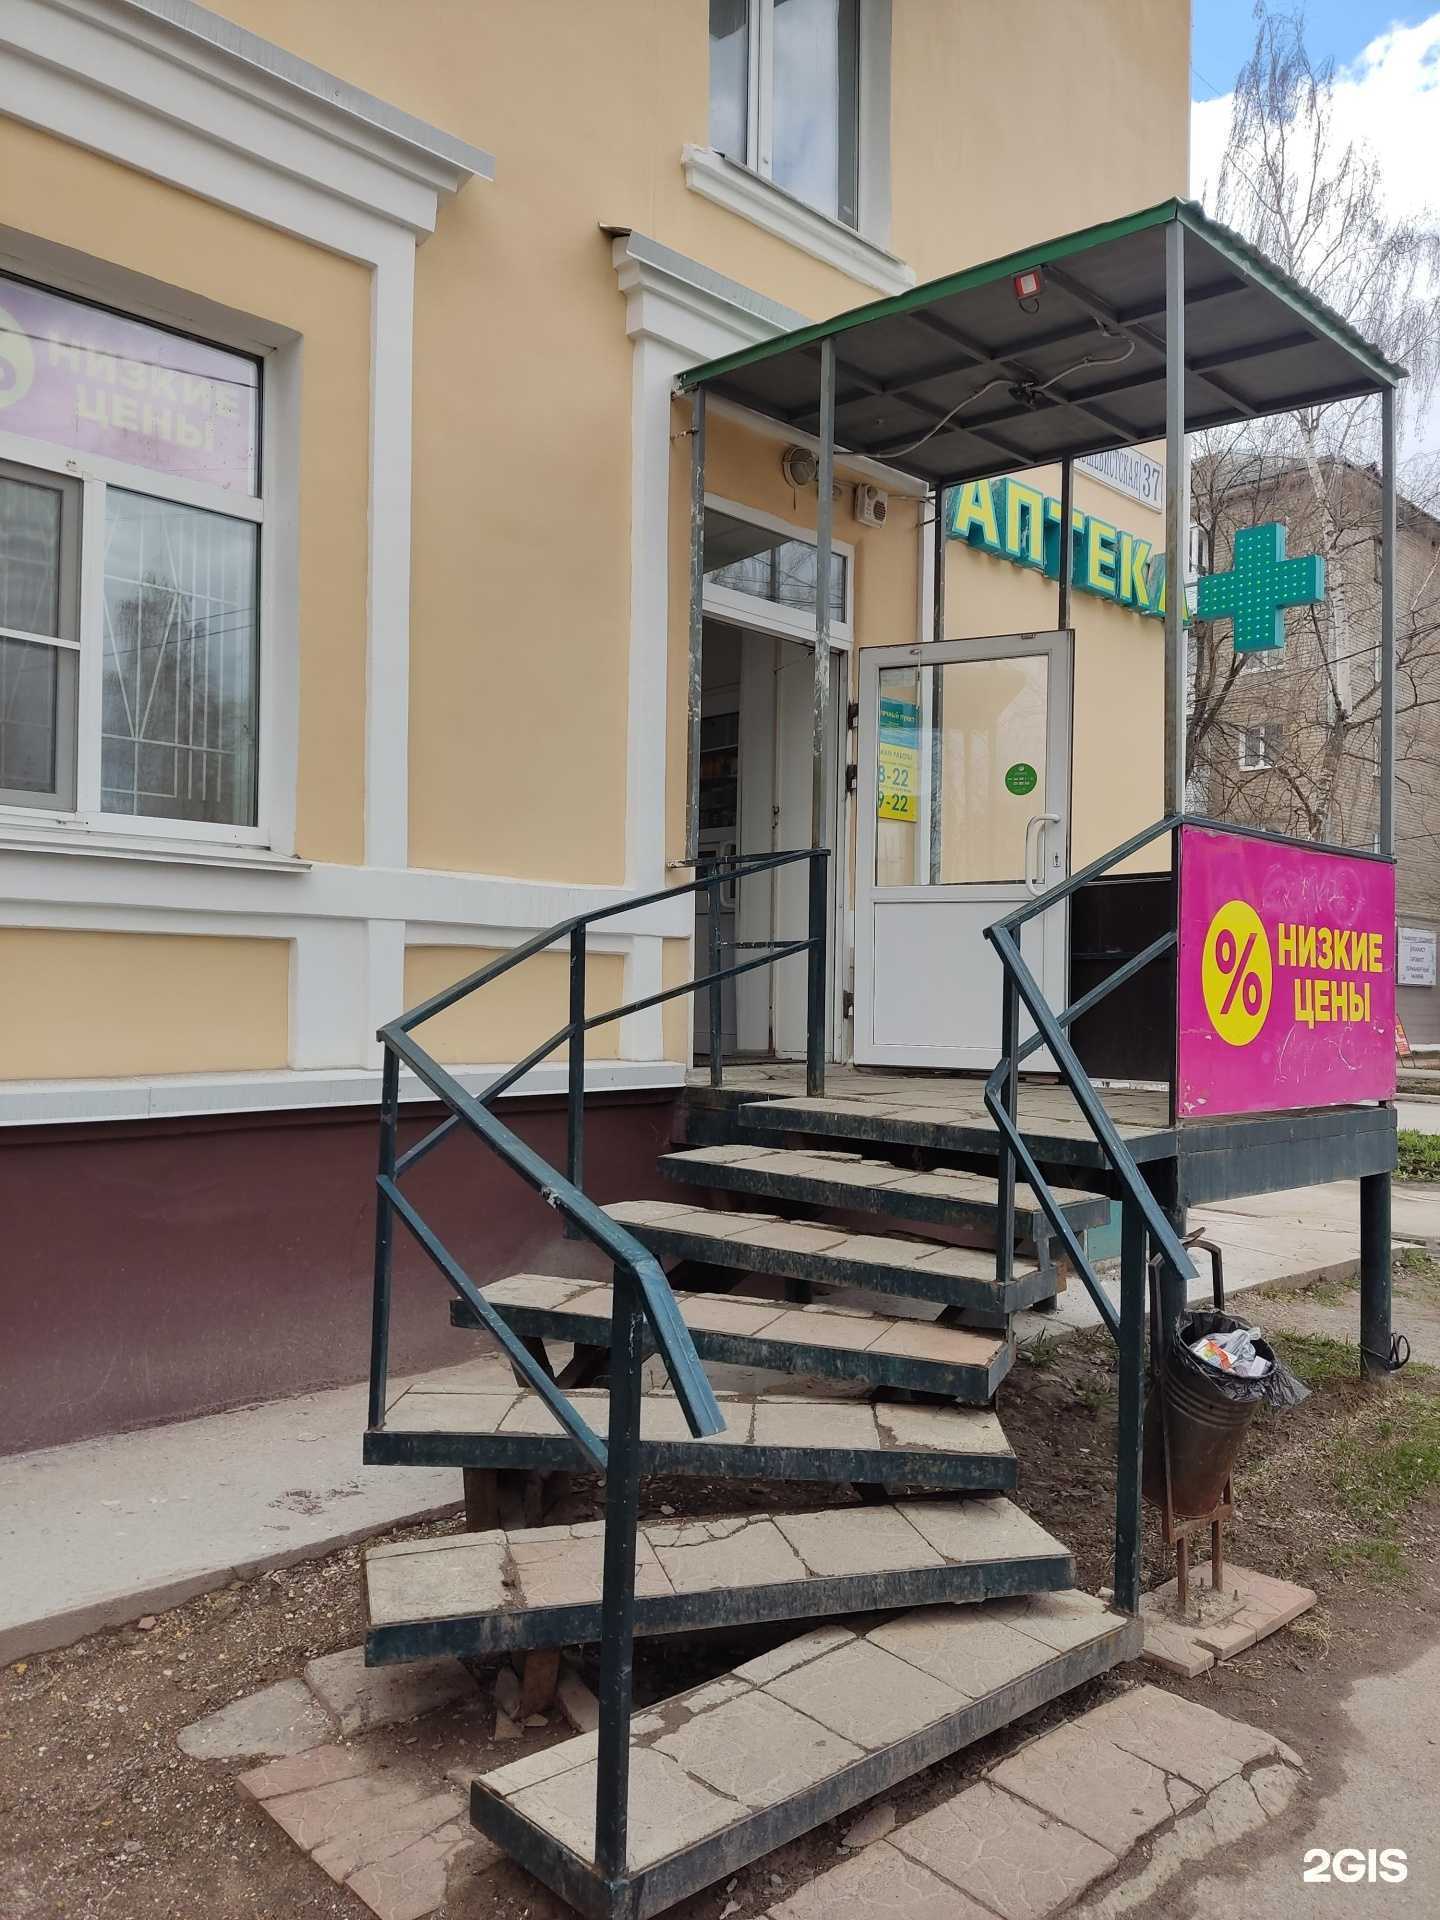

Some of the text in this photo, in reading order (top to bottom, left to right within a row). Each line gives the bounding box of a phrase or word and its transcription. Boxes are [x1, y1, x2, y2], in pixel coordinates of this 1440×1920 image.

[46, 332, 239, 418] НИЗКИЕ
[76, 384, 214, 450] ЦЕНЫ
[1142, 462, 1161, 502] 37
[1277, 922, 1384, 973] НИЗКИЕ
[1293, 978, 1371, 1029] ЦЕНЫ
